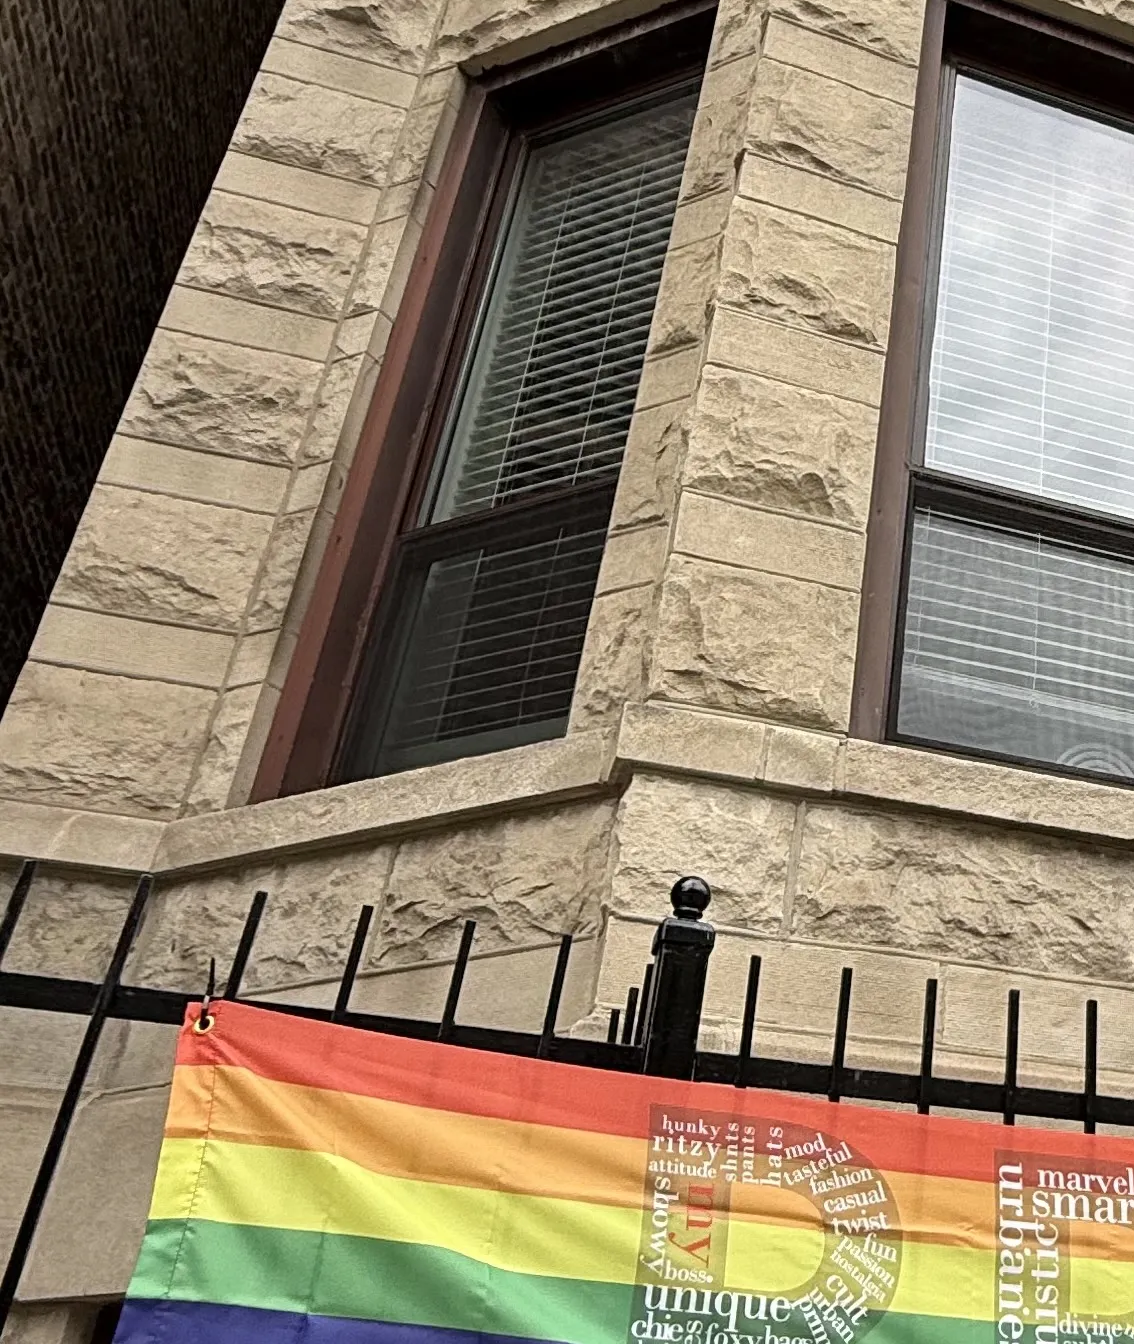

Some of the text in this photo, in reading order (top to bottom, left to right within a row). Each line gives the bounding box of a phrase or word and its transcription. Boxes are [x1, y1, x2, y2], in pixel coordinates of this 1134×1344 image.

[652, 1129, 722, 1165] ritzy
[662, 1115, 721, 1140] hunky
[784, 1132, 827, 1161] mod
[649, 1158, 717, 1179] attitude
[742, 1126, 760, 1185] pants
[760, 1126, 783, 1188] hats
[782, 1141, 853, 1187] tasteful
[808, 1166, 874, 1196] fashion
[823, 1180, 888, 1214] casual
[639, 1176, 680, 1278] showy
[668, 1182, 715, 1269] my
[830, 1209, 891, 1236] twist
[837, 1235, 895, 1289] passion
[863, 1232, 897, 1263] fun
[829, 1249, 886, 1303] nostalgia
[644, 1274, 792, 1333] unique
[810, 1286, 855, 1344] urban
[825, 1274, 868, 1327] cult
[1059, 1312, 1123, 1337] divine
